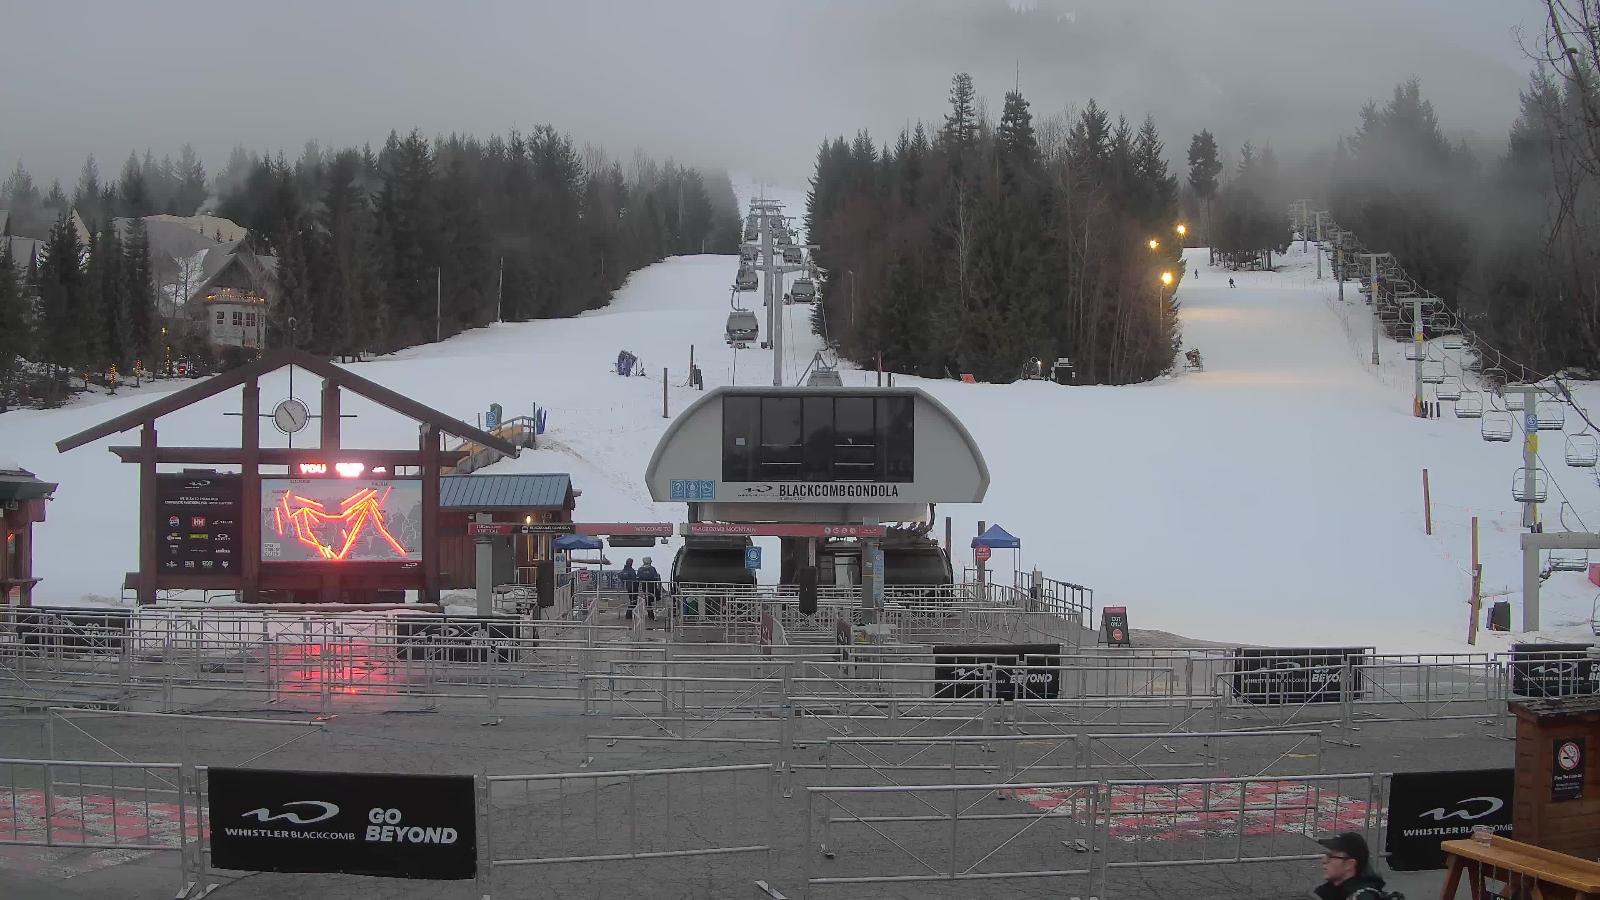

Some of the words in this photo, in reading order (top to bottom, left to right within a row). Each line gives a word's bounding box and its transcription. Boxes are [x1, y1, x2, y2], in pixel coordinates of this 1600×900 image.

[300, 463, 327, 474] YOU
[779, 484, 846, 497] BLACKCOMB
[847, 484, 899, 497] GONDOLA
[368, 807, 402, 824] GO
[224, 827, 290, 839] WHISTLER
[290, 830, 356, 840] BLACKCOMB
[365, 825, 458, 844] BEYOND
[1403, 826, 1459, 837] WHISTLER
